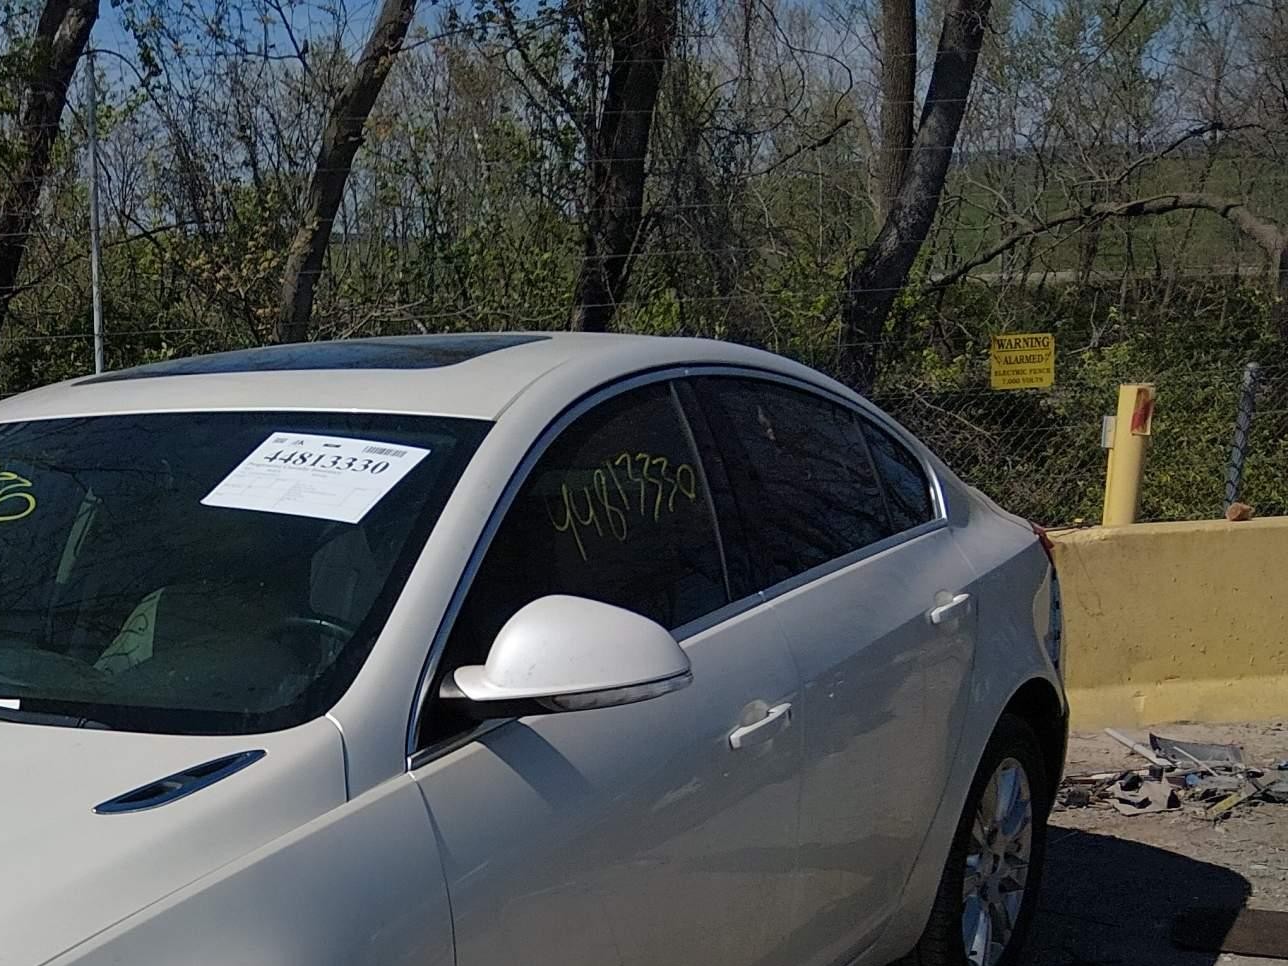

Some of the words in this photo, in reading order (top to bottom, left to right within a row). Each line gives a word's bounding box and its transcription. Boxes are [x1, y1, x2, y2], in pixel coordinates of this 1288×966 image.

[997, 337, 1050, 349] WARNING
[1003, 355, 1044, 365] ALARMED
[264, 449, 391, 475] 44813330
